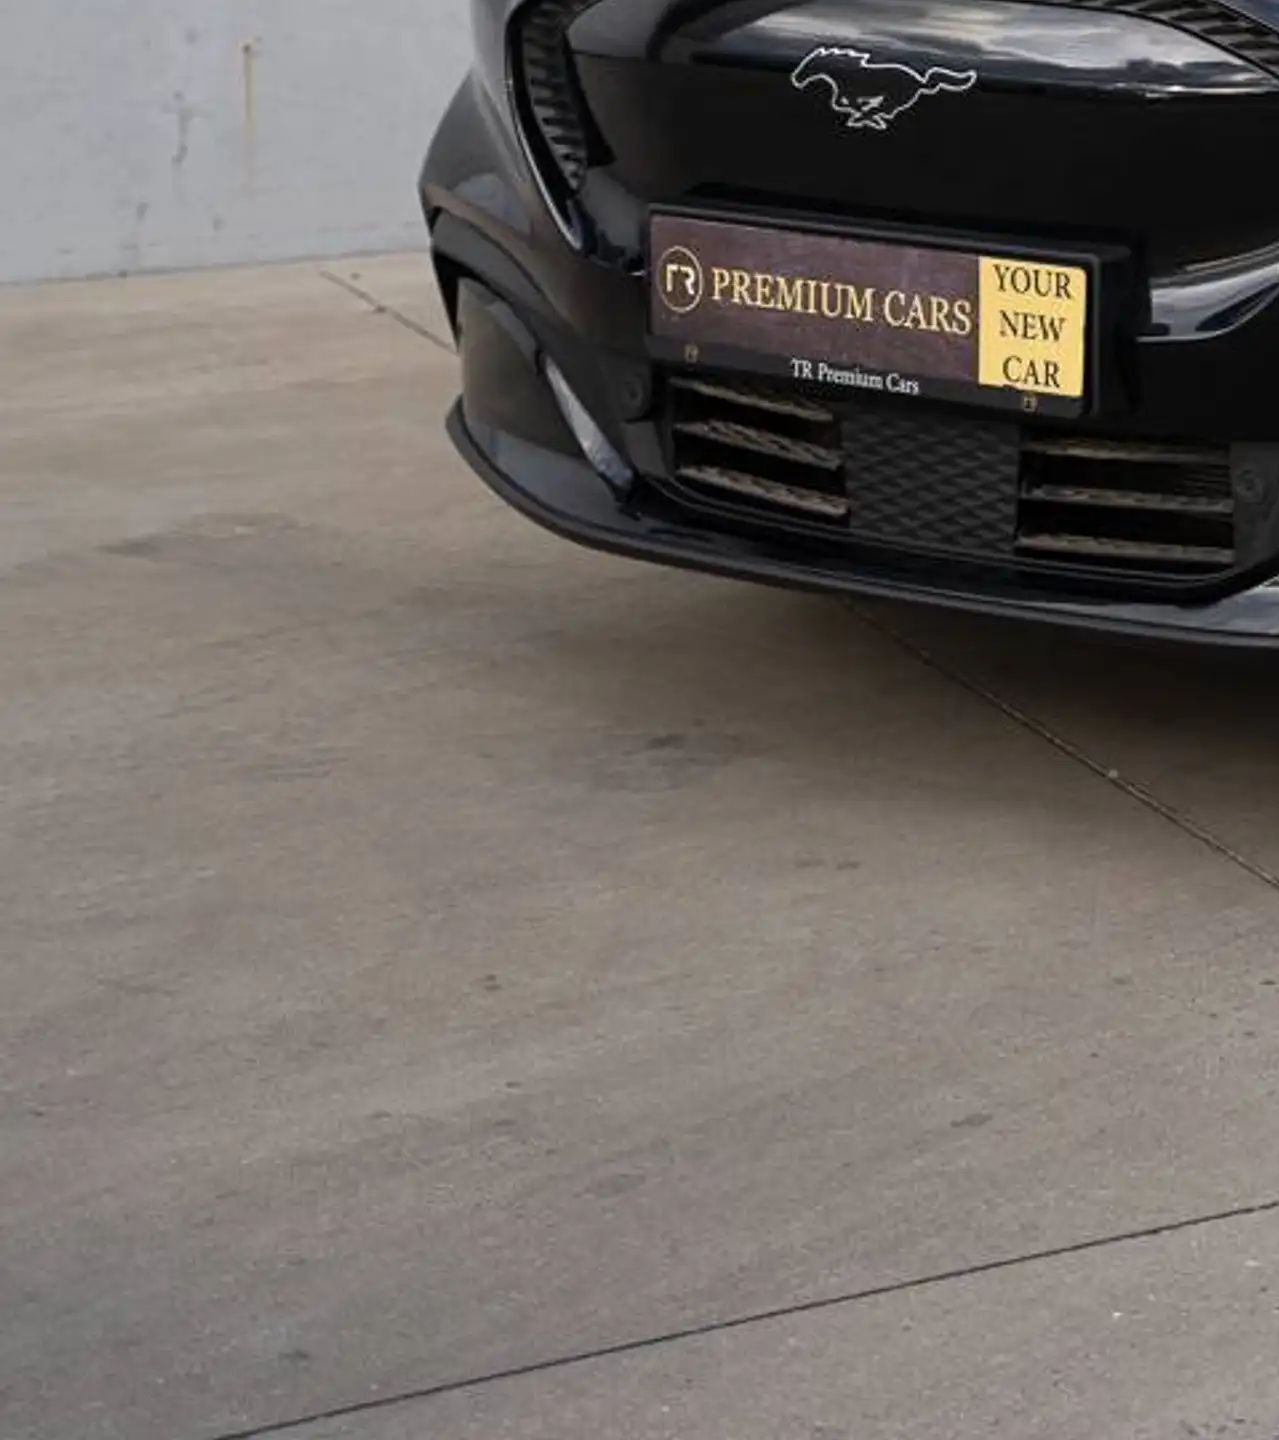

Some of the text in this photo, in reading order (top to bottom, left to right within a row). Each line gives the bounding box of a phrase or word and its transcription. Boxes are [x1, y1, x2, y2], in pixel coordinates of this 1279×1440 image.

[993, 263, 1072, 299] YOUR
[711, 267, 876, 322] PREMIUM
[883, 290, 972, 335] CARS
[999, 310, 1068, 342] NEW
[790, 358, 920, 396] TR Premium Cars
[1002, 355, 1061, 388] CAR
